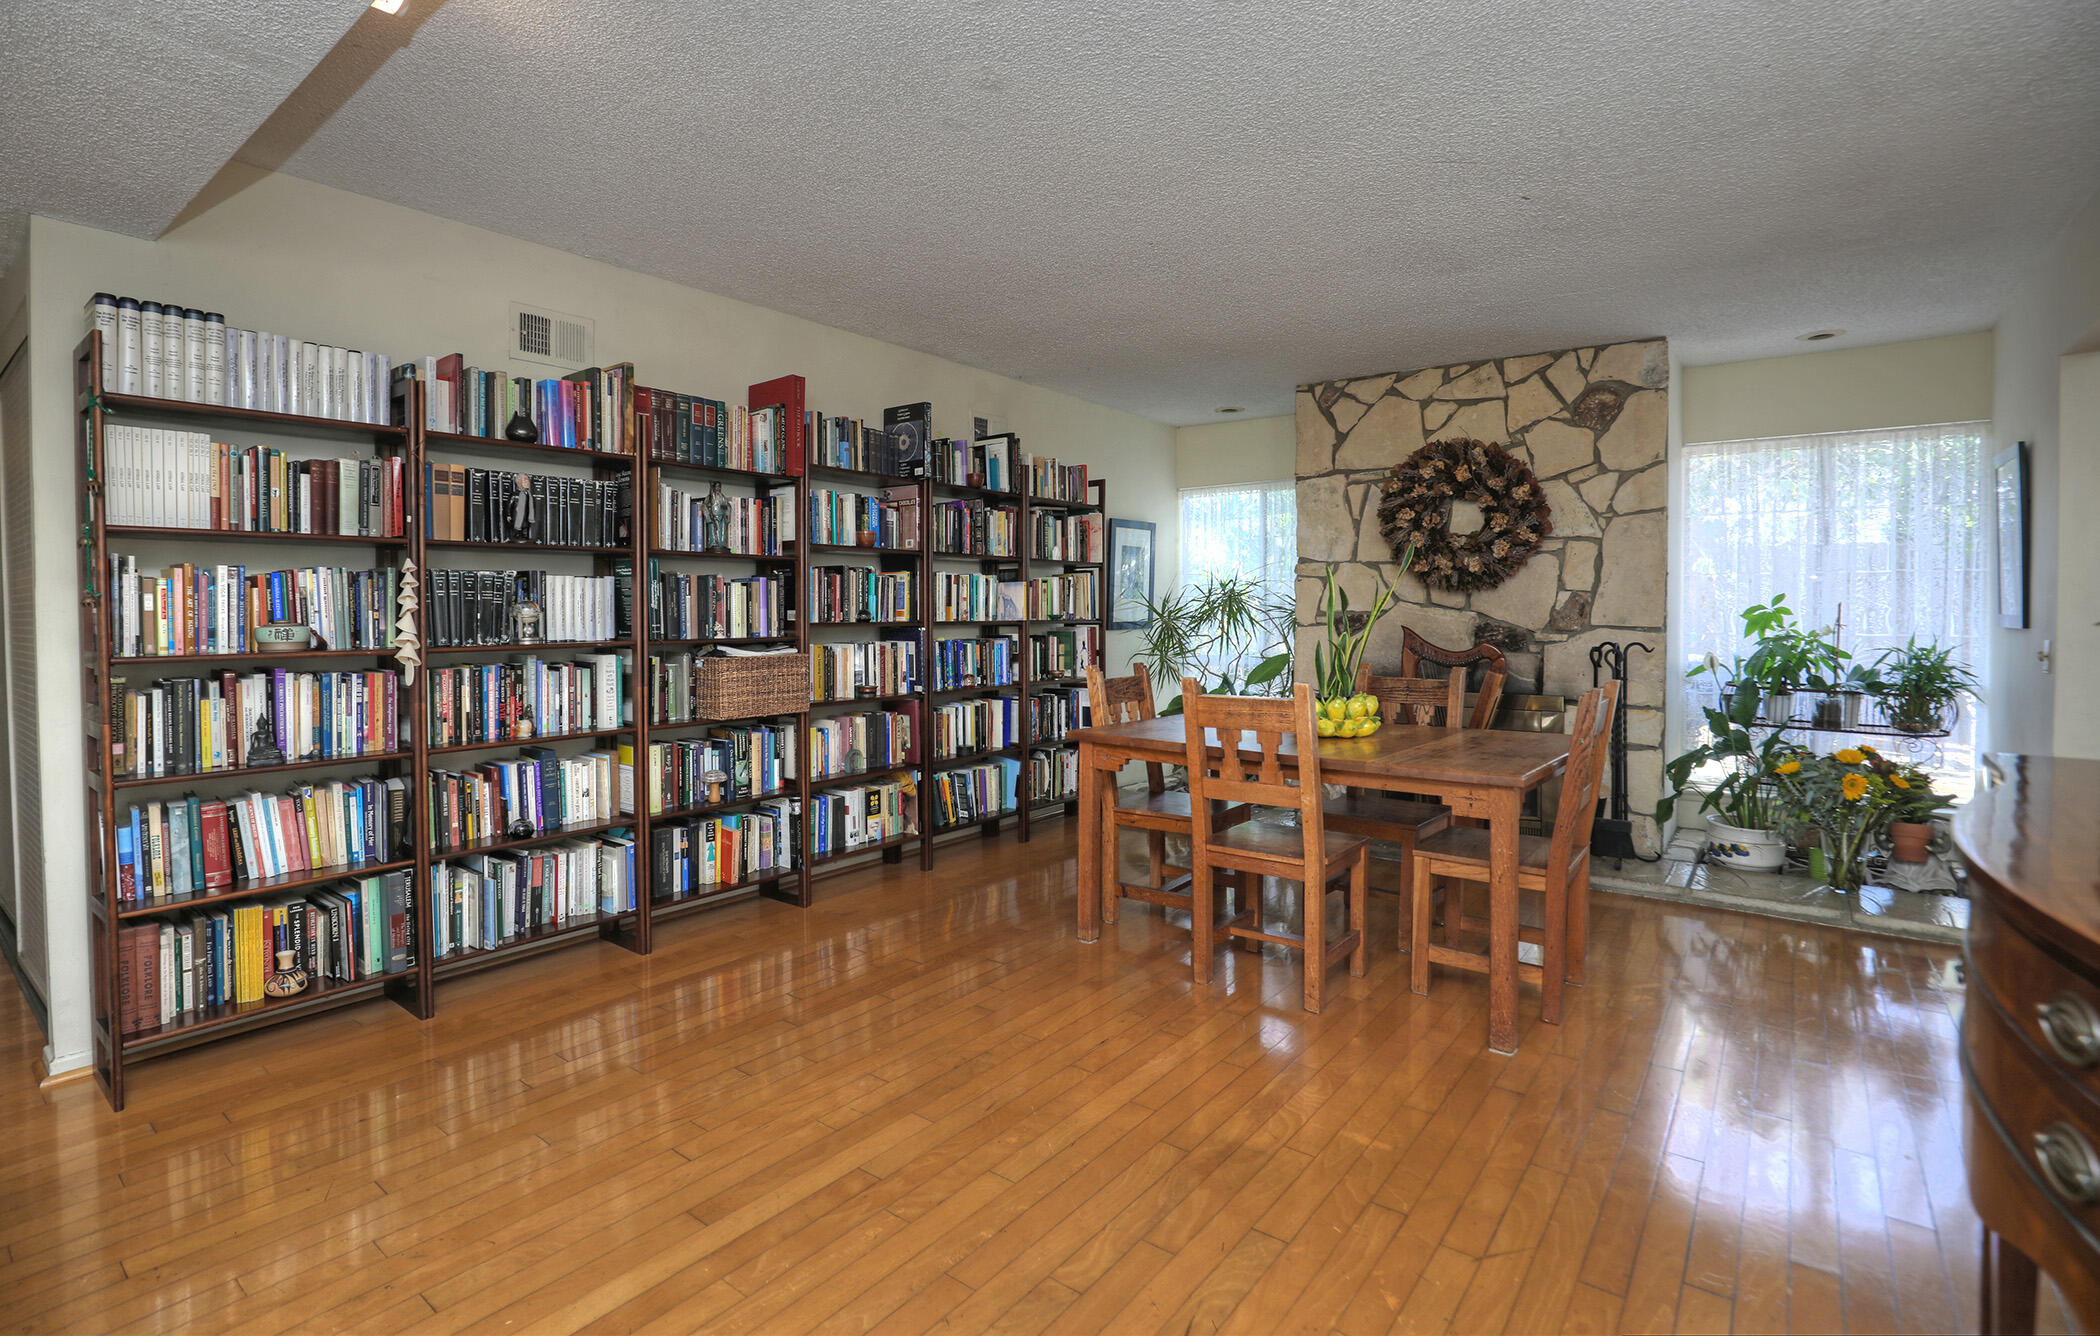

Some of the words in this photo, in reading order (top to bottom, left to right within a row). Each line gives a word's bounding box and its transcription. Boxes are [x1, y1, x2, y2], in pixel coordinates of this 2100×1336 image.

[152, 834, 162, 860] FOLKLORE
[120, 960, 130, 1005] FOLKLORE
[144, 955, 152, 1000] FOLKLORE
